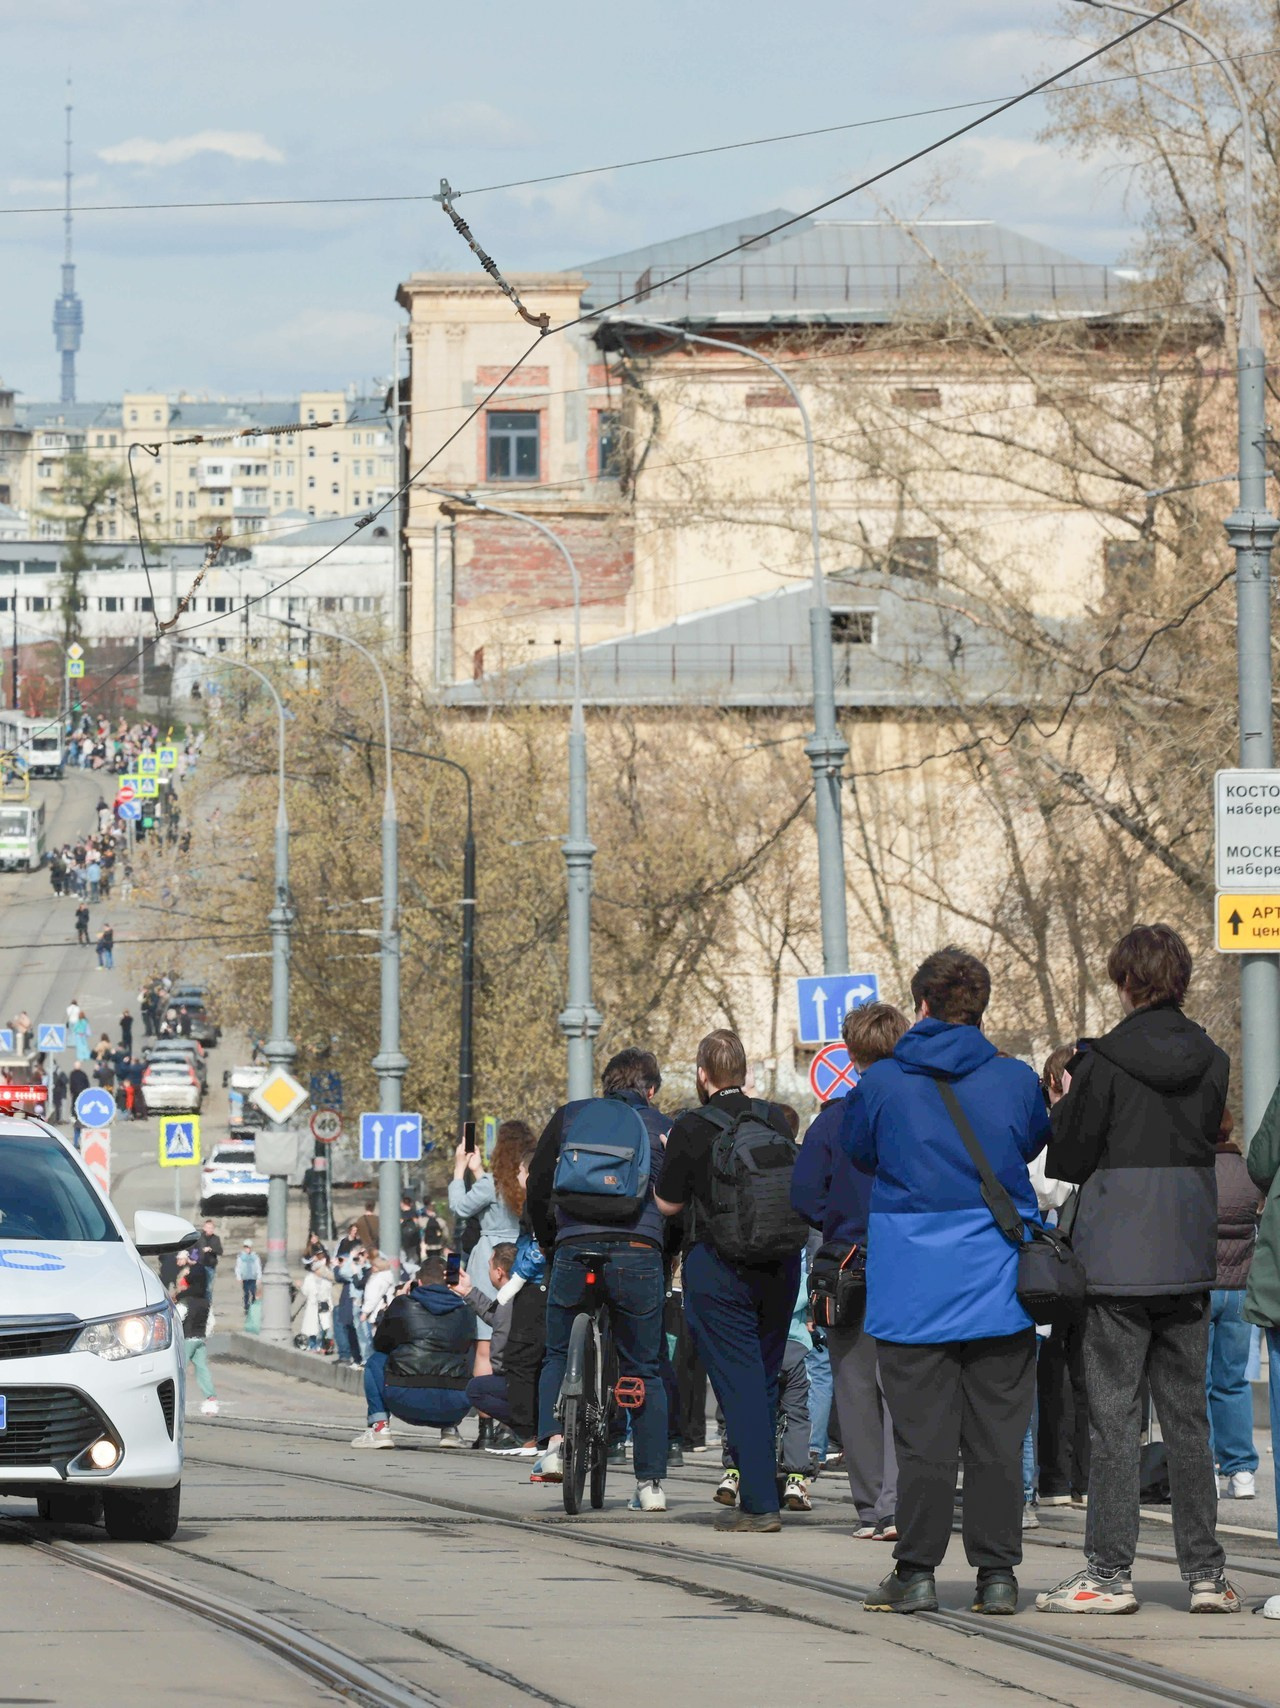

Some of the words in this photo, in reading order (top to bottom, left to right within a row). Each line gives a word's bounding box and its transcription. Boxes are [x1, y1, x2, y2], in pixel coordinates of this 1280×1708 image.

[1226, 785, 1280, 798] КОСТО
[1226, 803, 1280, 818] набере
[1226, 863, 1280, 878] набере
[317, 1118, 337, 1132] 40
